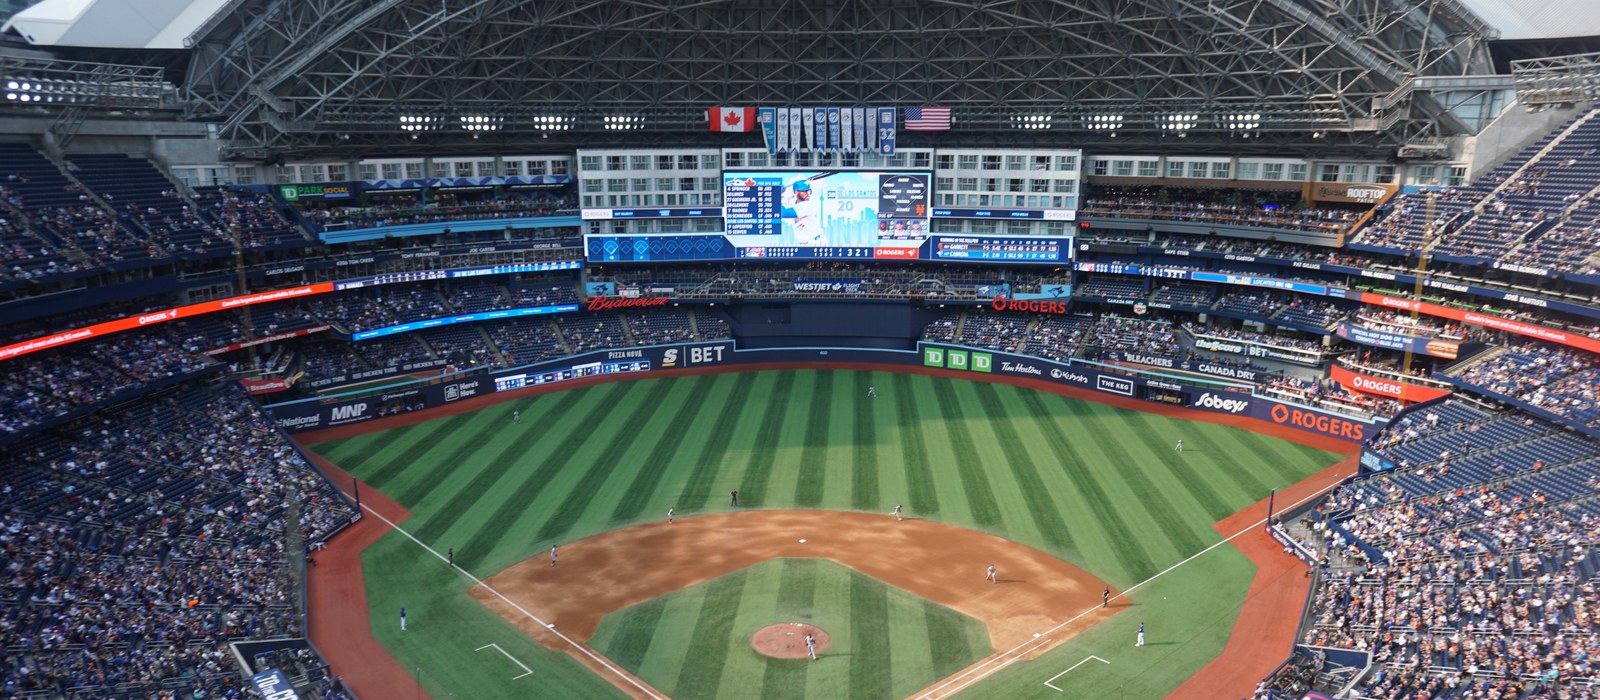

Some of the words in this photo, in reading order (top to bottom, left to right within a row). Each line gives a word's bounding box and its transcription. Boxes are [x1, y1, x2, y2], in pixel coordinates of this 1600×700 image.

[880, 128, 894, 140] 32
[1347, 188, 1386, 198] ROOFTOP
[838, 201, 853, 211] 20
[794, 283, 831, 292] WESTJET
[1431, 280, 1442, 288] ROY
[1443, 282, 1468, 291] HALLADAY
[585, 296, 669, 310] Budweiser
[1388, 298, 1410, 308] ROGERS
[1504, 293, 1518, 302] JOSÉ
[1519, 295, 1548, 307] BAUTISTA
[1009, 300, 1066, 314] ROGERS
[145, 312, 167, 323] ROGERS
[1195, 339, 1242, 353] theScore
[1250, 347, 1268, 357] BET
[608, 351, 626, 359] PIZZA
[691, 346, 725, 363] BET
[927, 352, 942, 363] TD
[950, 354, 966, 365] TD
[1126, 353, 1172, 367] BLEACHERS
[413, 361, 433, 369] NEXEN
[974, 356, 990, 368] TD
[363, 369, 382, 378] NEXEN
[383, 367, 397, 375] TIRE
[1001, 362, 1014, 372] Tim
[1015, 363, 1041, 375] Hortons
[1198, 364, 1235, 377] CANADA
[311, 378, 331, 387] NEXEN
[332, 375, 346, 383] TIRE
[1062, 371, 1088, 383] Kubota
[459, 381, 479, 391] Here's
[1101, 380, 1114, 388] THE
[1115, 382, 1129, 391] KEG
[1363, 379, 1401, 394] ROGERS
[1195, 392, 1248, 413] Sobeys
[331, 403, 367, 420] MNP
[283, 414, 319, 427] National
[1292, 409, 1364, 440] ROGERS
